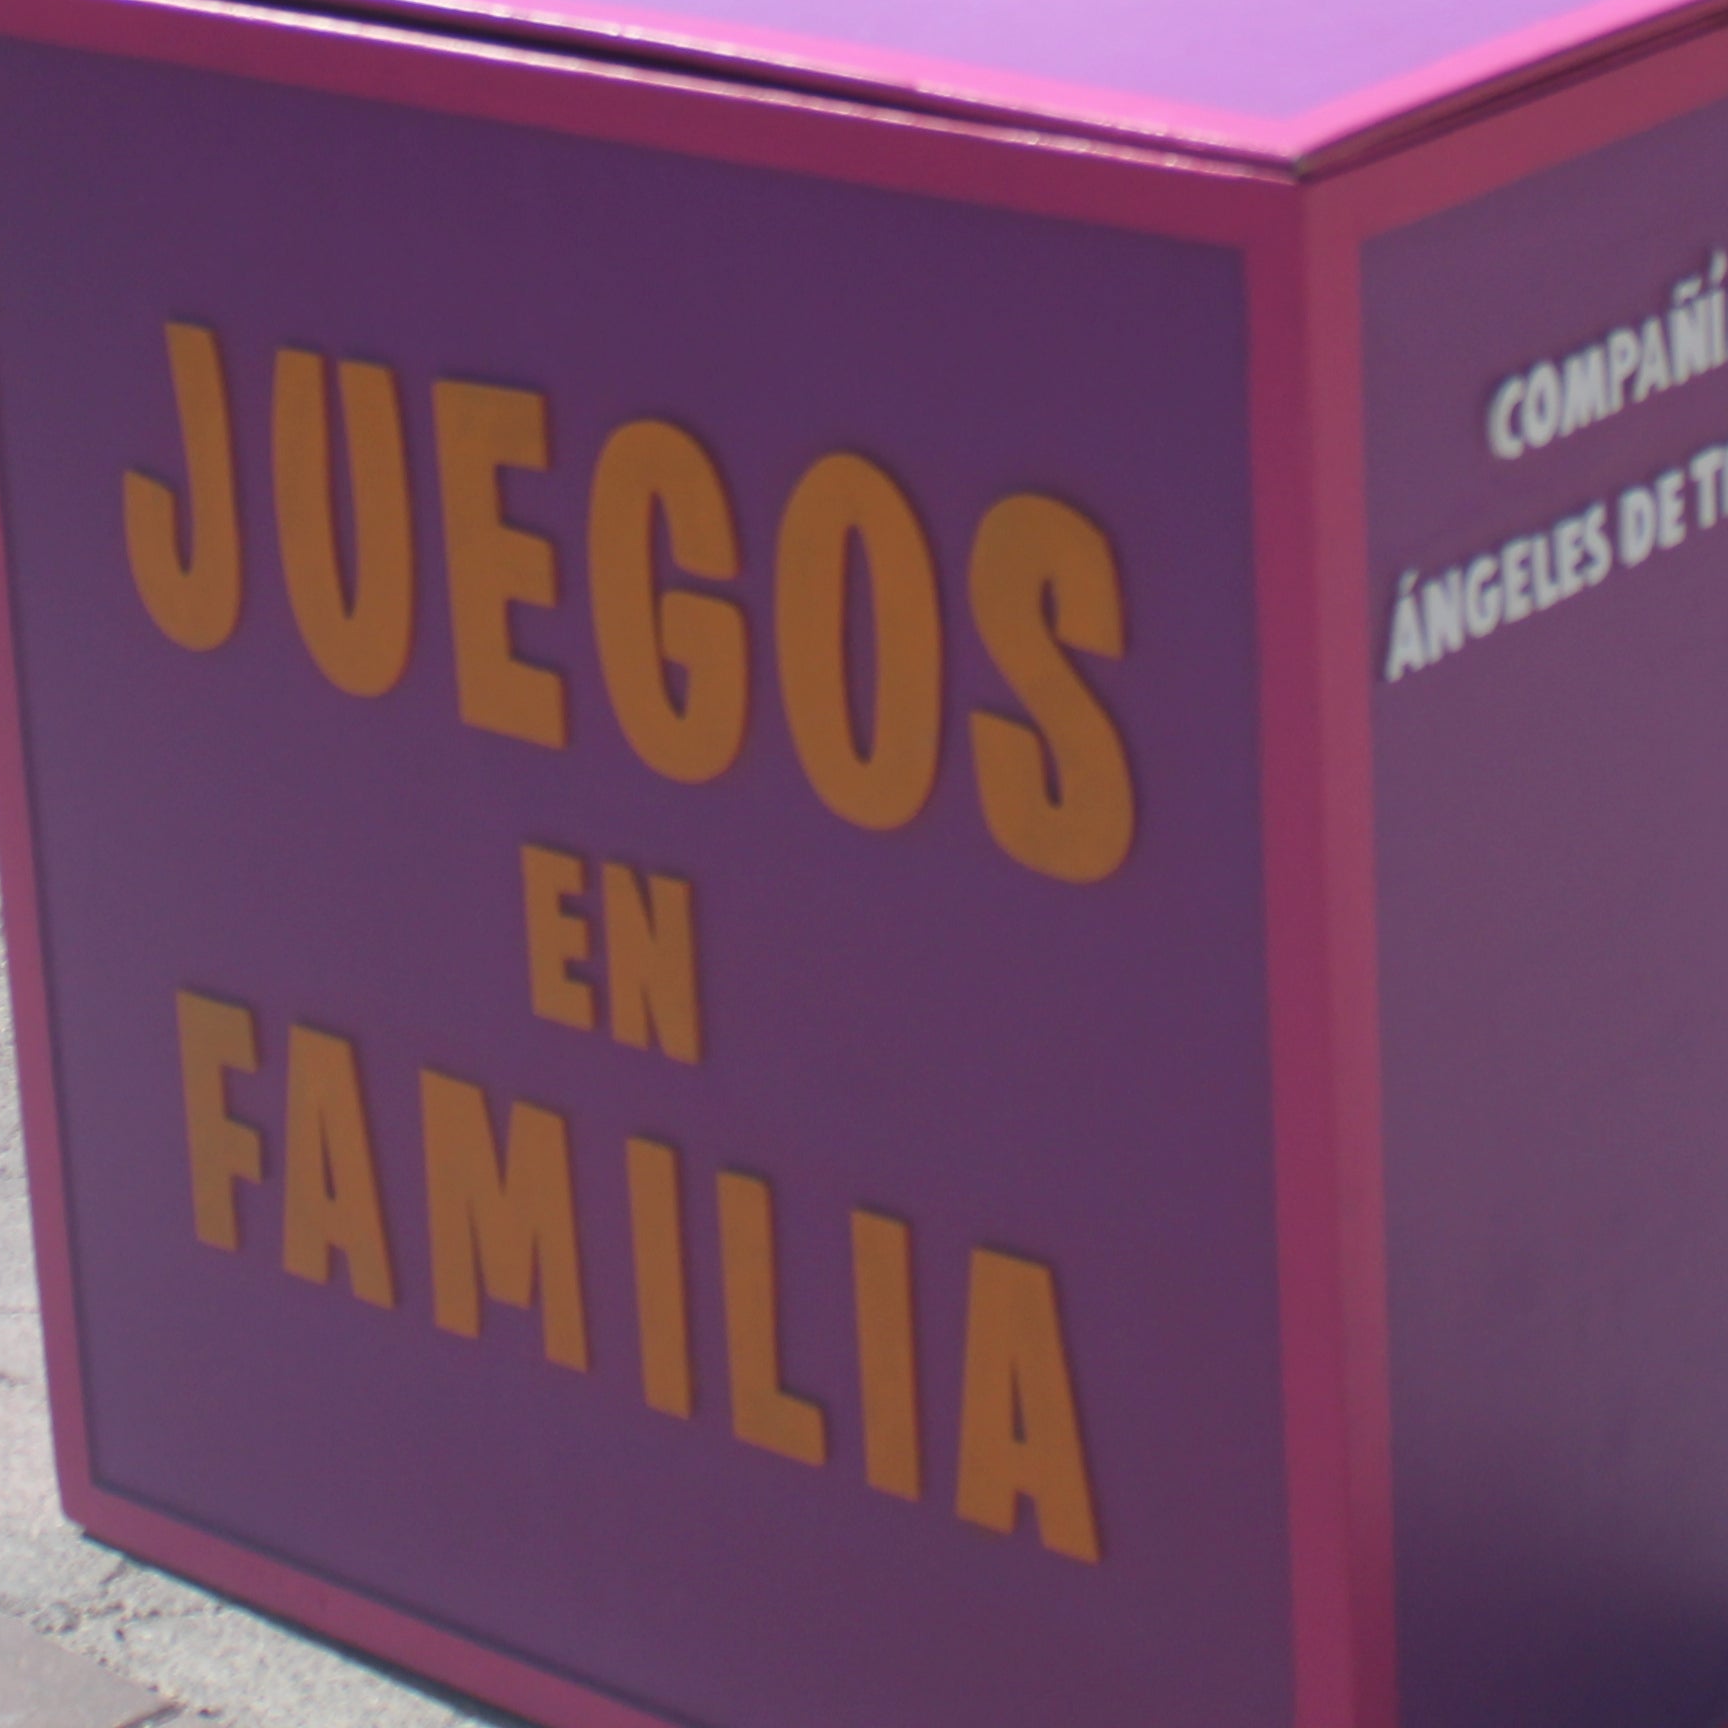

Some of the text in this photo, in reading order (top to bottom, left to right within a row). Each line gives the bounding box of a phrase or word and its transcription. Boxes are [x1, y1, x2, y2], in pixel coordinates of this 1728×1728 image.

[120, 320, 1136, 885] JUEGOS
[1385, 499, 1613, 683] ÁNGELES
[1617, 470, 1687, 569] DE
[520, 845, 700, 1065] EN
[175, 988, 1101, 1564] FAMILIA
